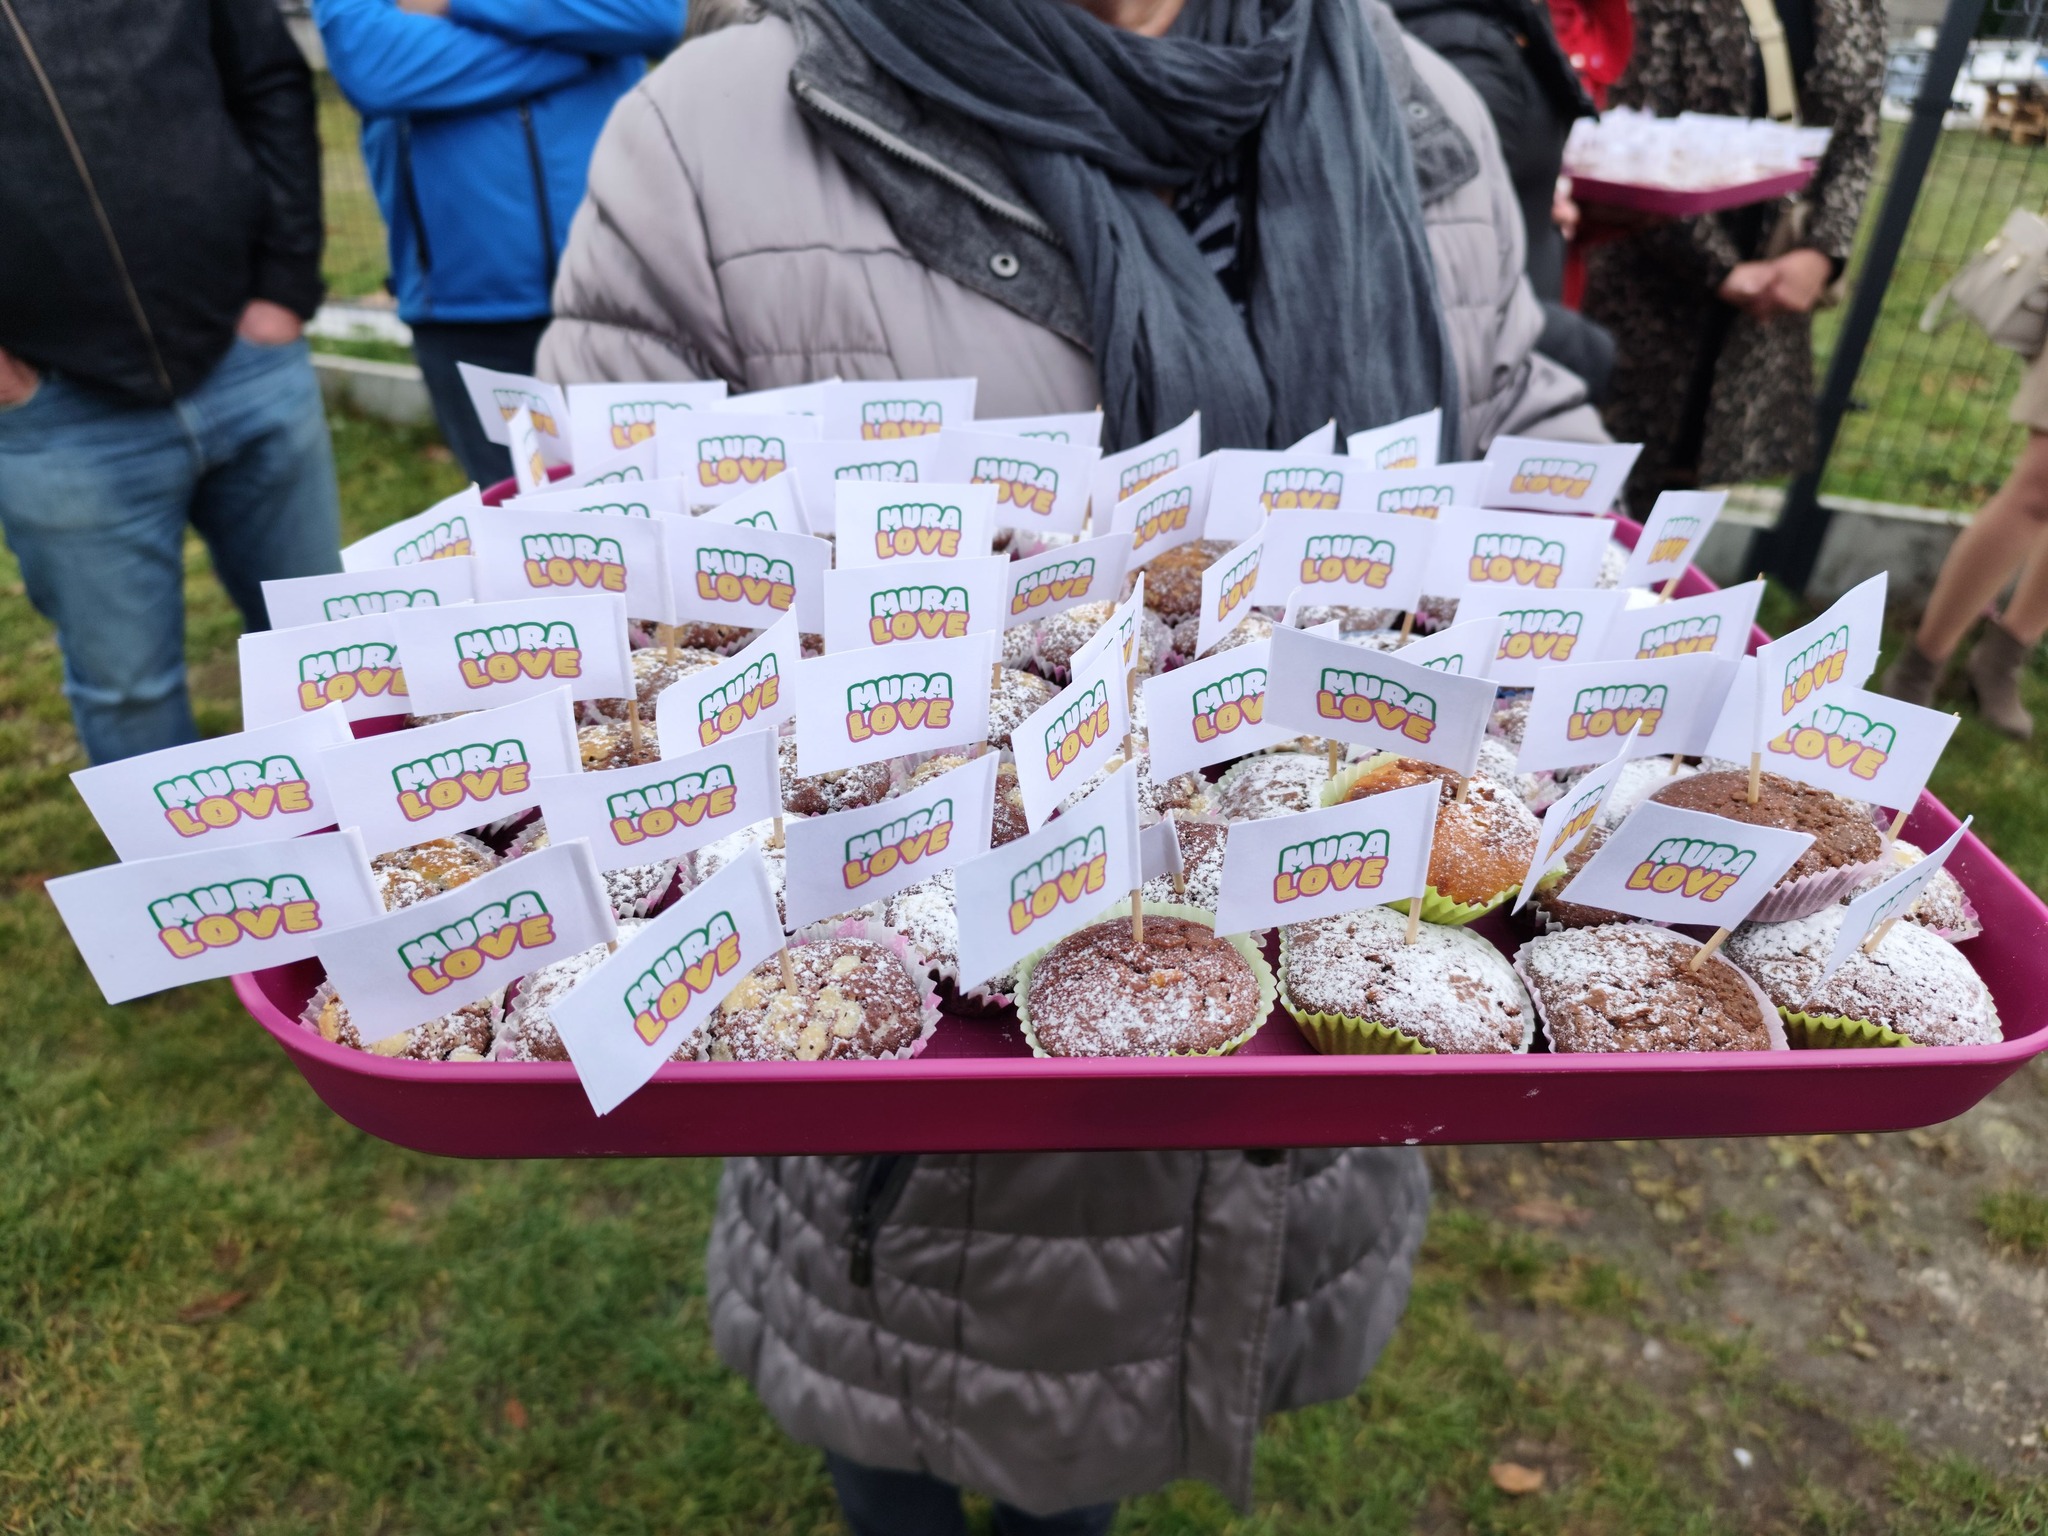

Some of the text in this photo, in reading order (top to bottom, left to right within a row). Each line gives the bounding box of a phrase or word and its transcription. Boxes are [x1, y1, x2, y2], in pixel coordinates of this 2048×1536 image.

[862, 400, 942, 425] MURA
[698, 435, 785, 464] MURA
[1518, 458, 1597, 481] MURA
[970, 476, 1057, 516] OVE
[973, 457, 1059, 492] MURA
[1263, 468, 1344, 495] MURA
[1509, 474, 1592, 499] LOVE
[877, 503, 962, 533] MURA
[1136, 486, 1192, 530] MURA
[394, 516, 470, 566] MURA
[522, 533, 624, 566] MURA
[875, 526, 962, 559] LOVE
[1305, 534, 1395, 567] MURA
[1473, 533, 1565, 567] MURA
[524, 556, 627, 592] LOVE
[697, 548, 795, 587] MURA
[1016, 557, 1095, 597] MURA
[1301, 556, 1393, 589] LOVE
[1469, 555, 1564, 589] LOVE
[696, 571, 796, 611] LOVE
[871, 585, 968, 619] MURA
[1011, 575, 1094, 615] LOVE
[455, 621, 579, 662] MURA
[869, 609, 970, 645] LOVE
[1498, 610, 1583, 637] MURA
[1640, 615, 1721, 650] MURA
[299, 642, 398, 684] MUR
[459, 647, 583, 690] LOVE
[1784, 625, 1849, 690] MURA
[699, 653, 779, 723] MURA
[847, 672, 953, 713] MURA
[1193, 667, 1268, 717] MUR
[1320, 667, 1437, 723] MURA
[1573, 684, 1669, 718] MURA
[1781, 649, 1848, 716] LOVE
[699, 674, 780, 748] LOVE
[846, 698, 954, 743] LOVE
[1044, 678, 1108, 755] MURA
[1192, 691, 1265, 744] LOV
[1316, 689, 1437, 744] LOVE
[1566, 707, 1663, 741] LOVE
[1790, 703, 1897, 755] URA
[1046, 700, 1110, 782] LOVE
[1767, 726, 1889, 781] LOVE
[153, 755, 306, 810] MURA
[391, 738, 529, 793] MURA
[164, 779, 314, 838] LOVE
[396, 761, 531, 822] LOVE
[607, 764, 736, 821] MURA
[610, 784, 738, 846] LOVE
[845, 798, 953, 864] MURA
[842, 821, 953, 889] LOVE
[1010, 825, 1107, 903] MURA
[1278, 828, 1390, 875] MURA
[1645, 838, 1757, 877] MURA
[1008, 853, 1107, 935] LOVE
[1273, 855, 1389, 904] LOVE
[1625, 859, 1740, 903] LOVE
[147, 873, 315, 931] MURA
[158, 899, 323, 960] LOVE
[397, 889, 549, 970] MURA
[407, 911, 557, 996] LOVE
[624, 910, 737, 1020] MURA
[633, 930, 741, 1047] LOVE
